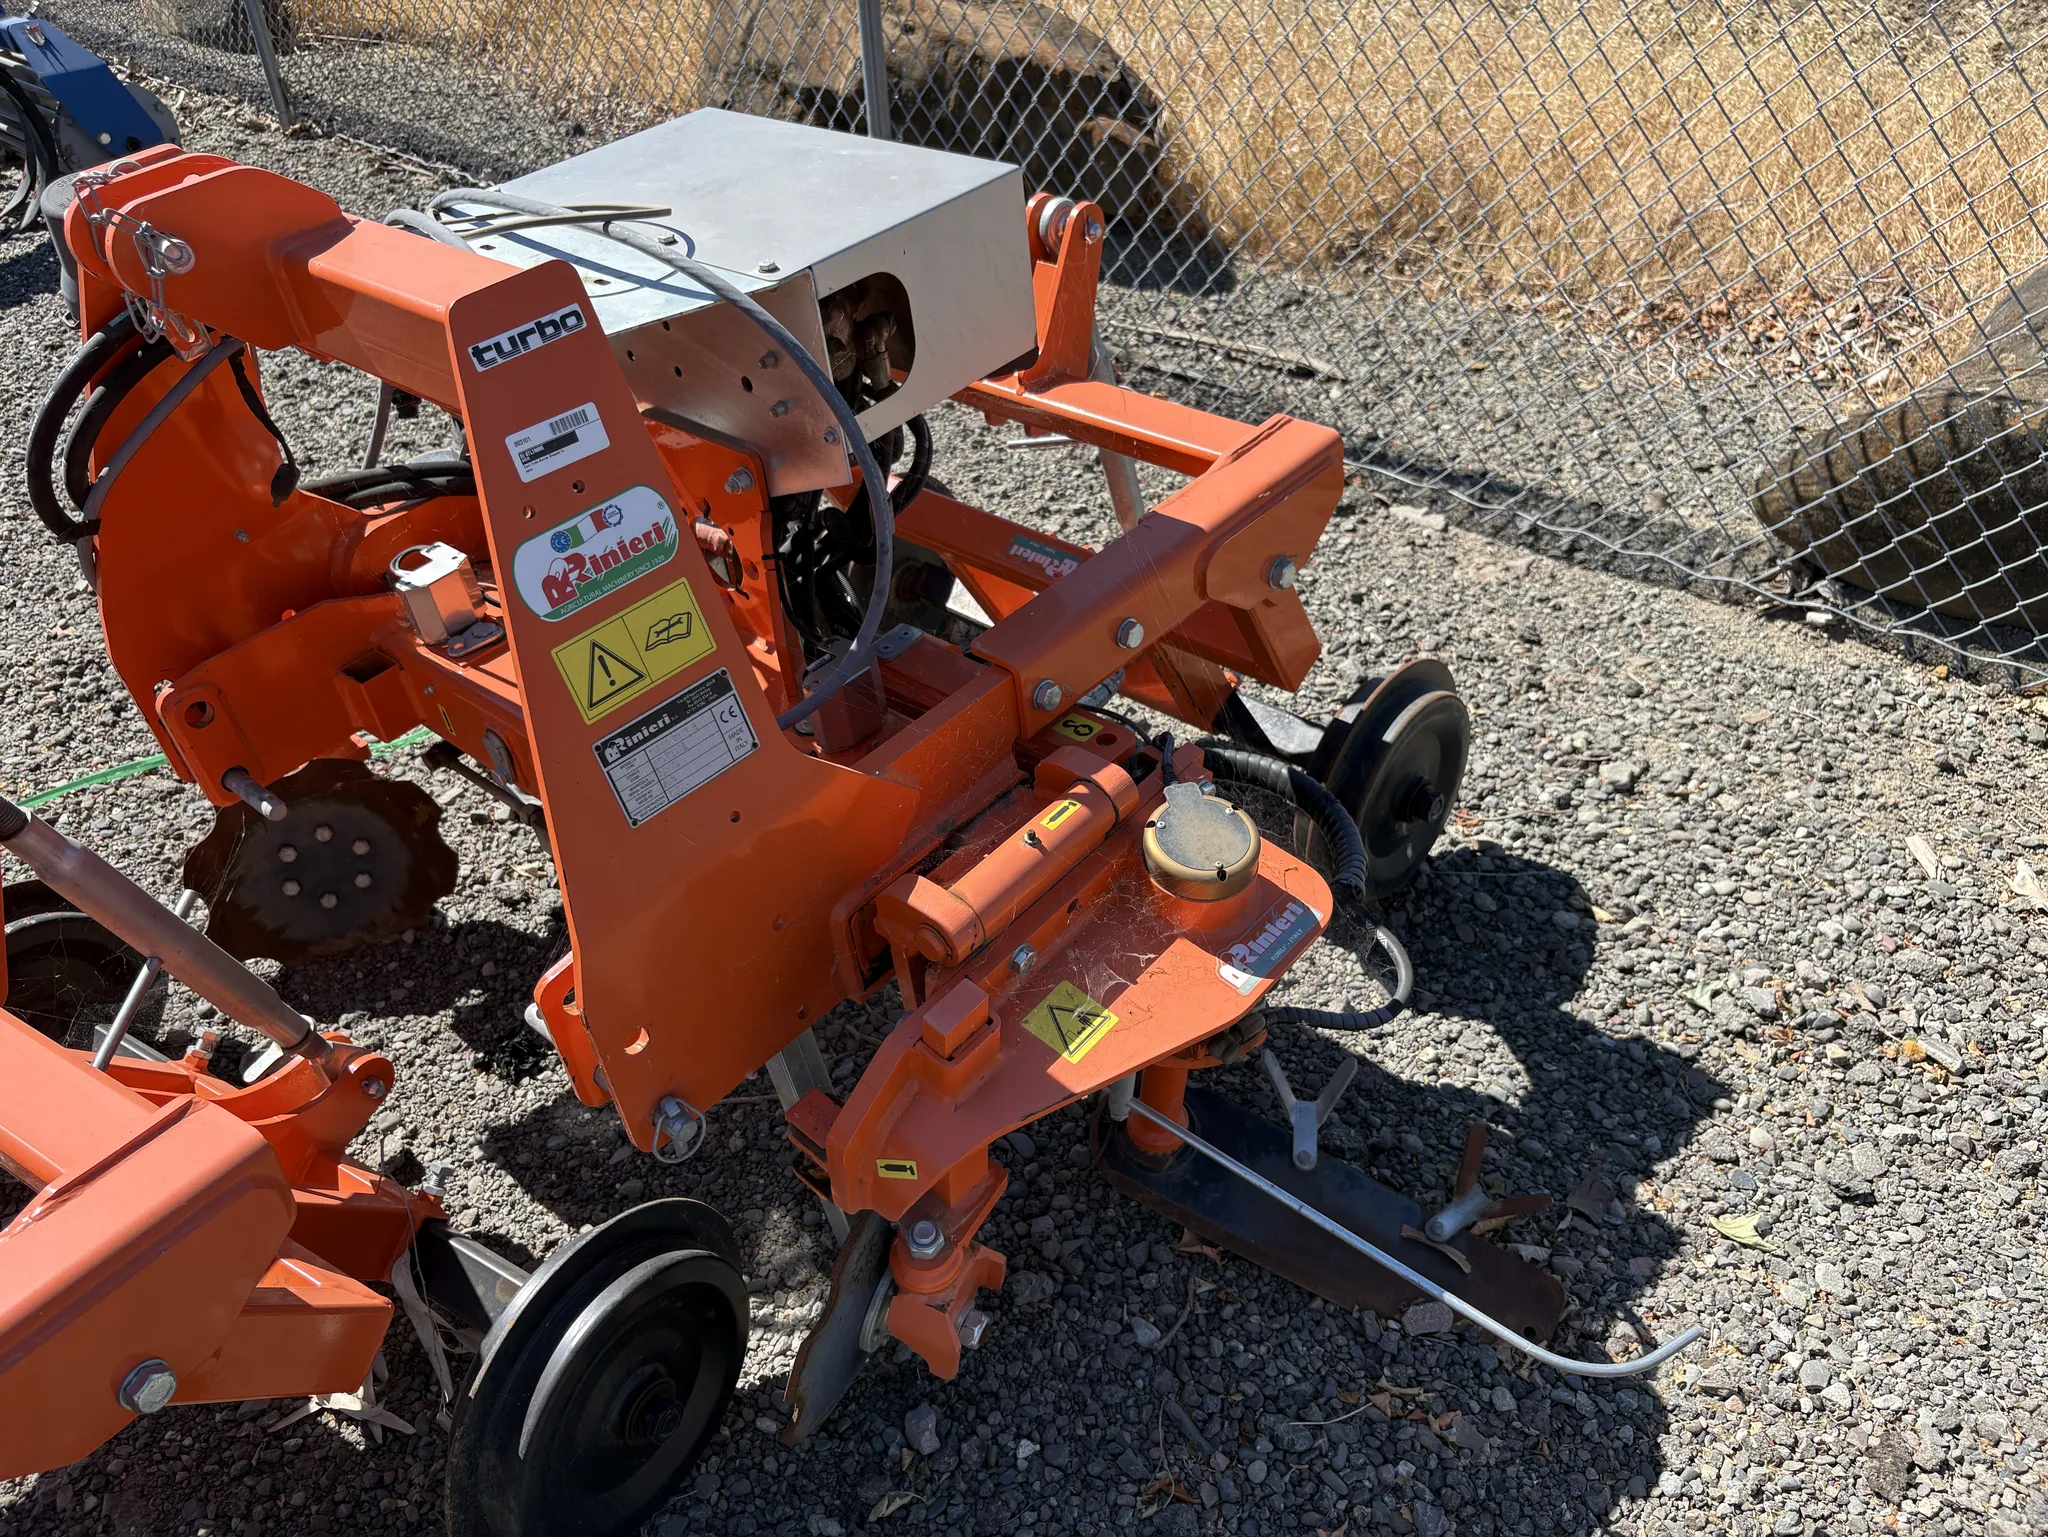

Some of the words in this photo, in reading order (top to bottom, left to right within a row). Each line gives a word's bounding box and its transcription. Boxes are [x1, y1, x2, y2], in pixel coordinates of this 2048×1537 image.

[471, 309, 584, 368] turbo
[560, 588, 602, 616] AGRICULTURAL
[602, 570, 635, 593] MACHINERY
[635, 561, 652, 575] SINCE
[651, 554, 666, 567] 1920
[720, 705, 738, 723] CE
[614, 713, 671, 751] Rinieri
[728, 726, 745, 740] MADE
[734, 740, 749, 752] ITALY
[1289, 928, 1304, 943] ITALY
